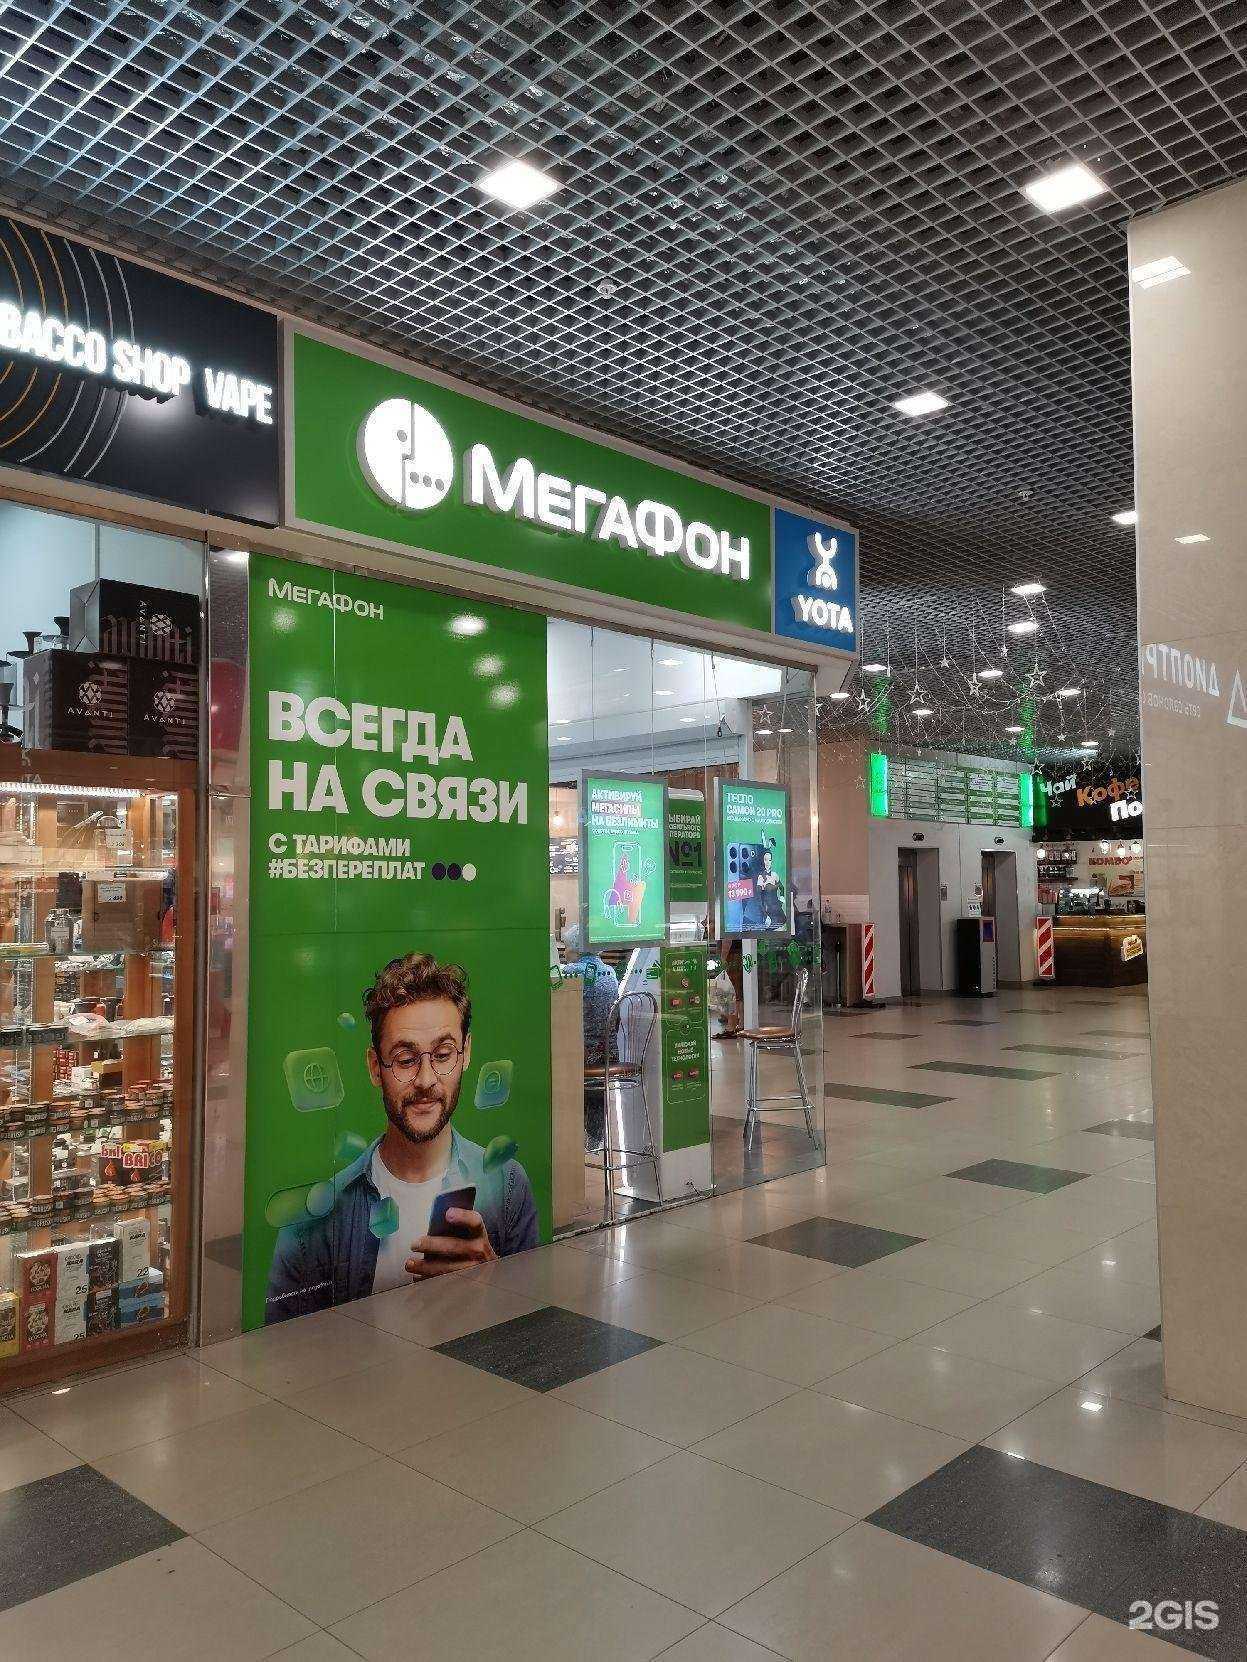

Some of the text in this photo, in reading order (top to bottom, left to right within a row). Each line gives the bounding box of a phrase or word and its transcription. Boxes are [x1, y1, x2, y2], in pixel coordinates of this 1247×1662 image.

[113, 340, 191, 396] SHOP
[203, 367, 274, 425] VAPE
[468, 443, 752, 581] МЕГАФОН
[267, 577, 384, 620] МЕГАФОН
[796, 594, 855, 634] YOTA
[267, 689, 474, 766] ВСЕГДА
[267, 759, 528, 825] НА СВЯЗИ
[668, 815, 701, 824] ЫБИРАЙ
[268, 833, 411, 857] С ТАРИФАМИ
[268, 858, 425, 880] #БЕЗПЕРЕПЛАТ
